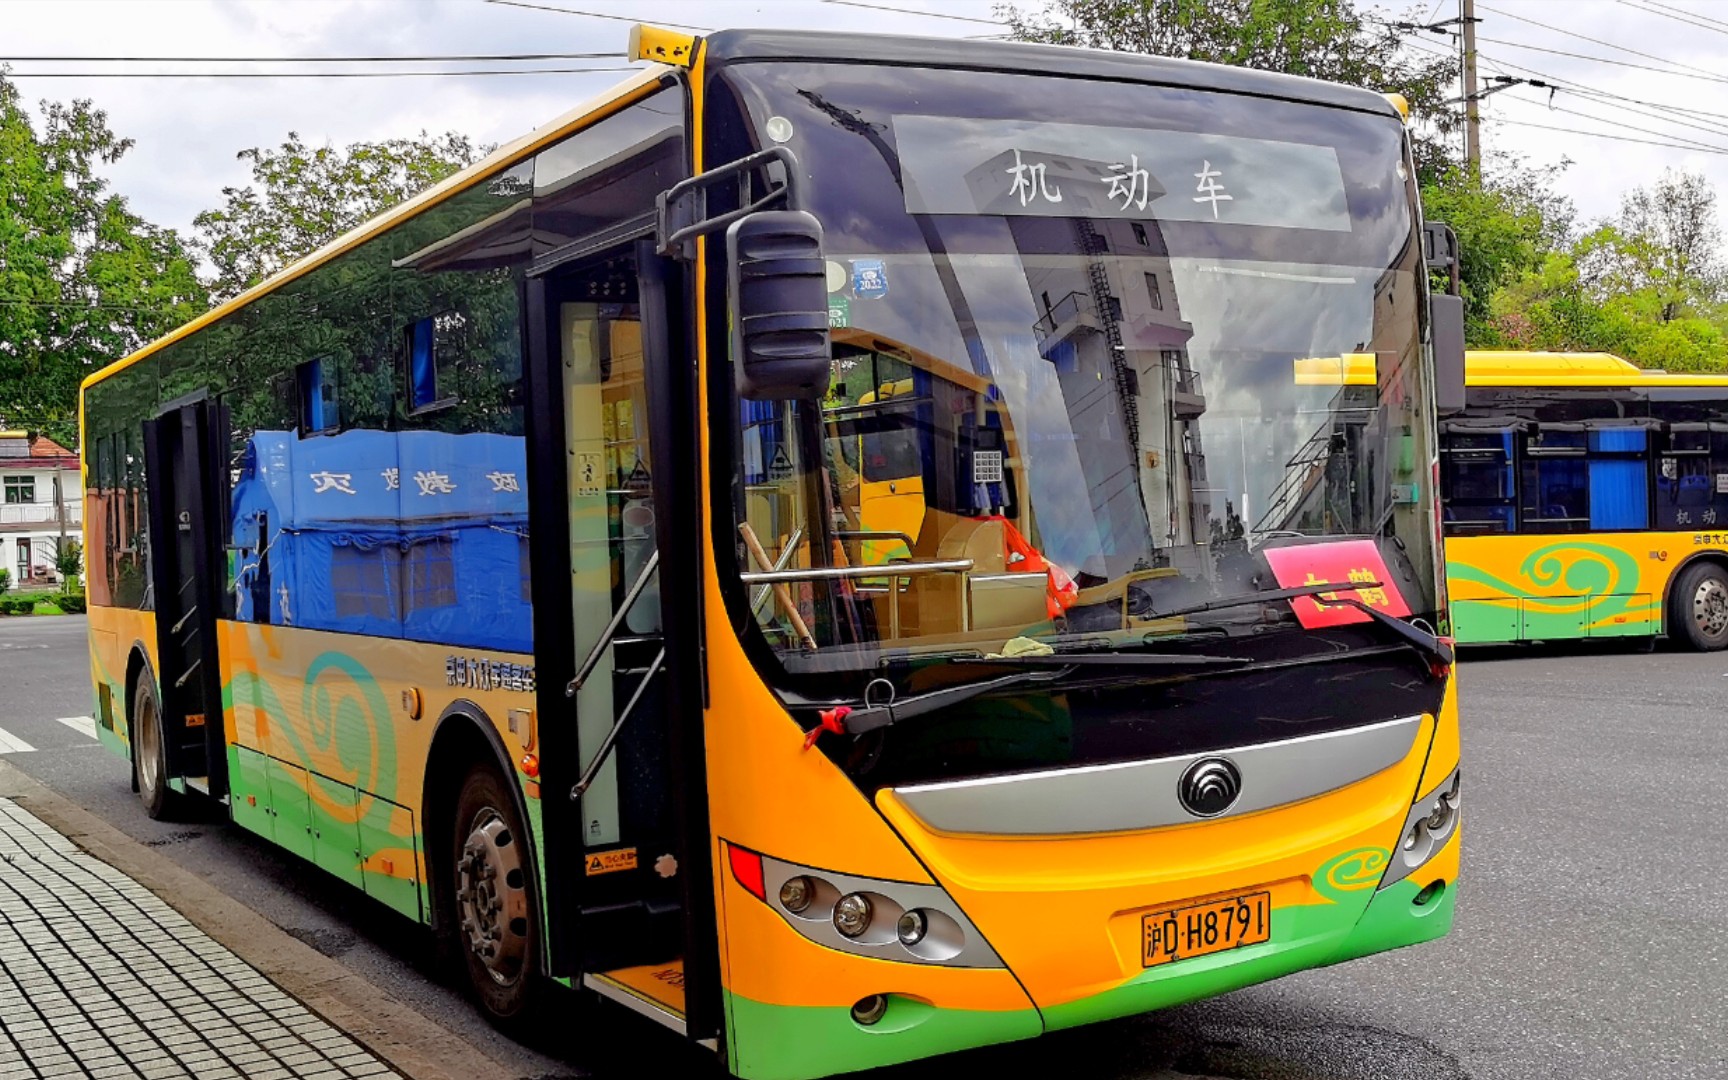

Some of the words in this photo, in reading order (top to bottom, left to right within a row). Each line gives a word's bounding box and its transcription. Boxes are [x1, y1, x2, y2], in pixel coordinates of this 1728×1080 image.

[1005, 149, 1234, 219] 机动车
[860, 280, 882, 291] 2022
